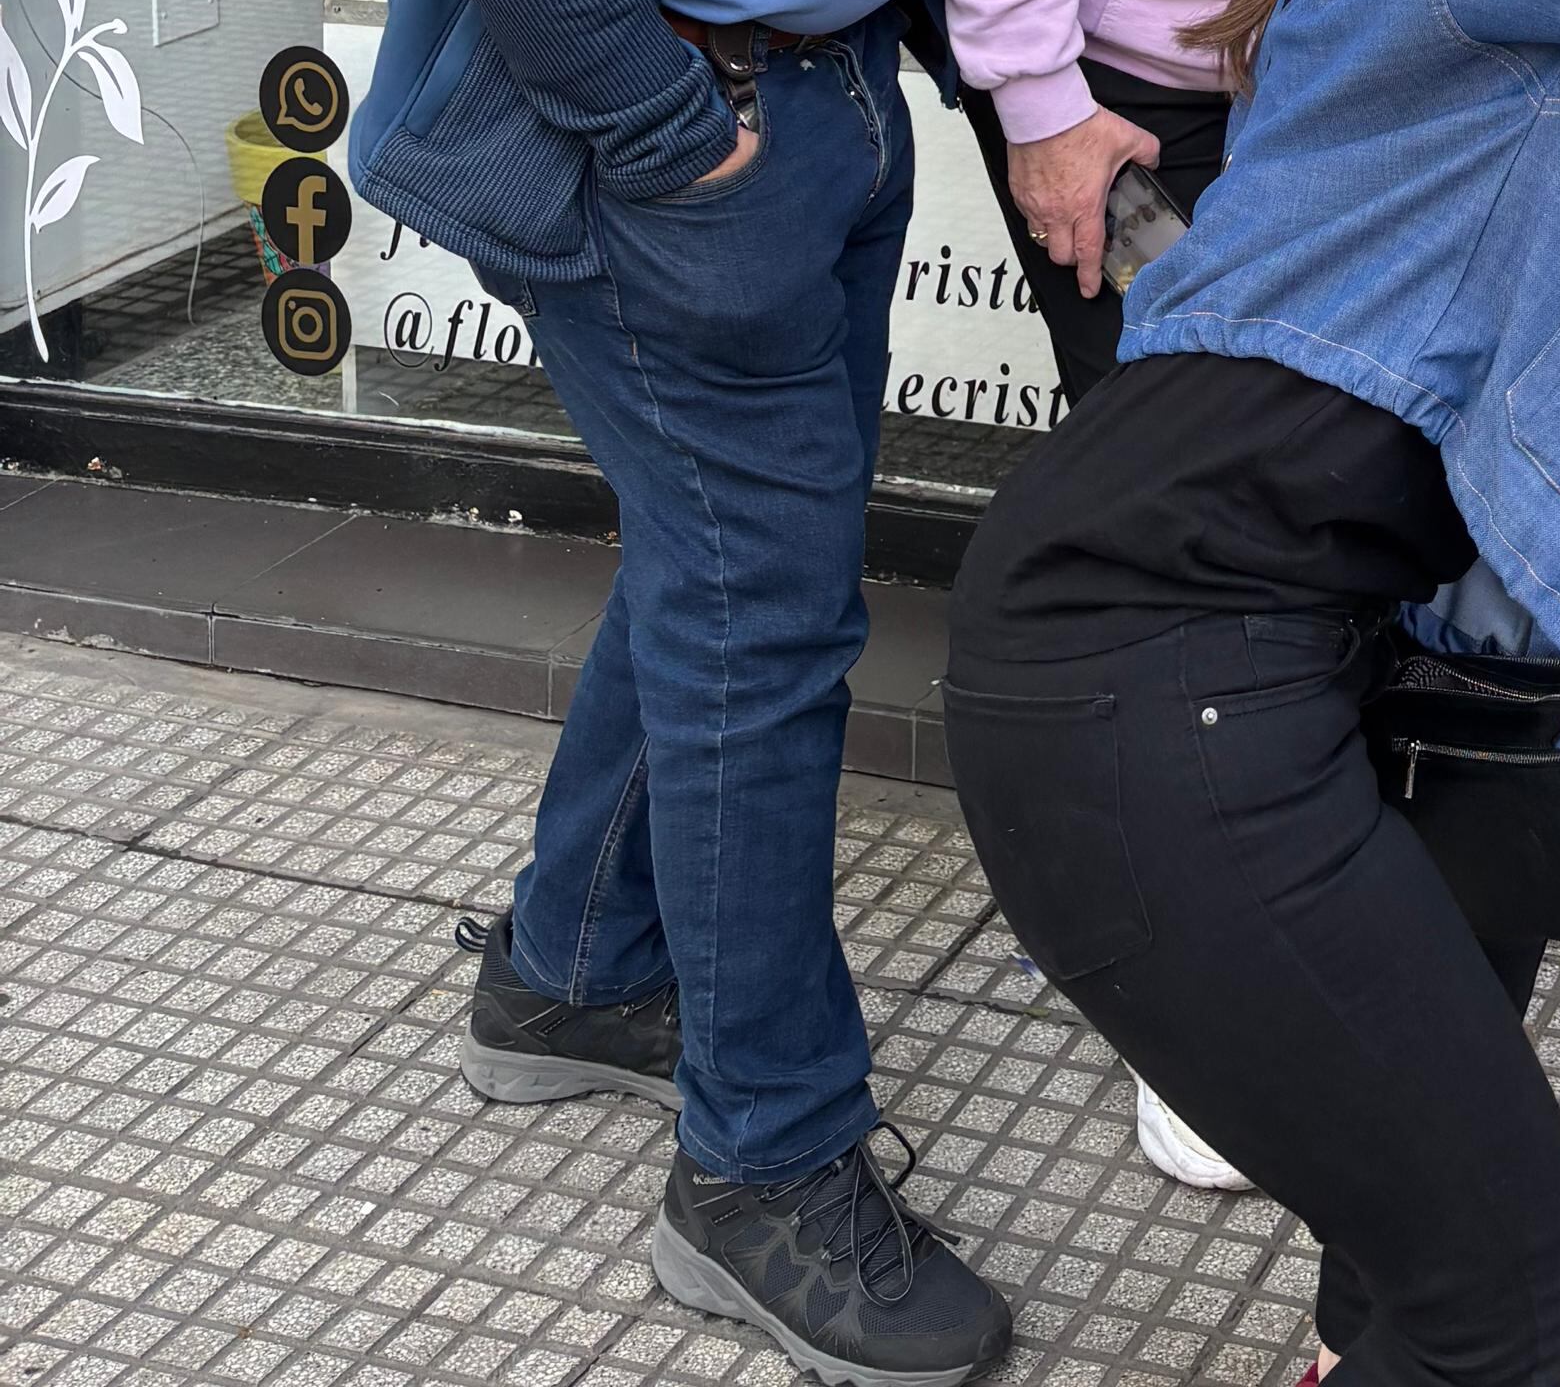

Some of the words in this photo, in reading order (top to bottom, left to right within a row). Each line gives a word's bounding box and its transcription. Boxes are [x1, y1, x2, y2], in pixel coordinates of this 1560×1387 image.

[905, 245, 1041, 314] rista
[384, 292, 537, 372] @flo
[881, 352, 1068, 427] ecrist
